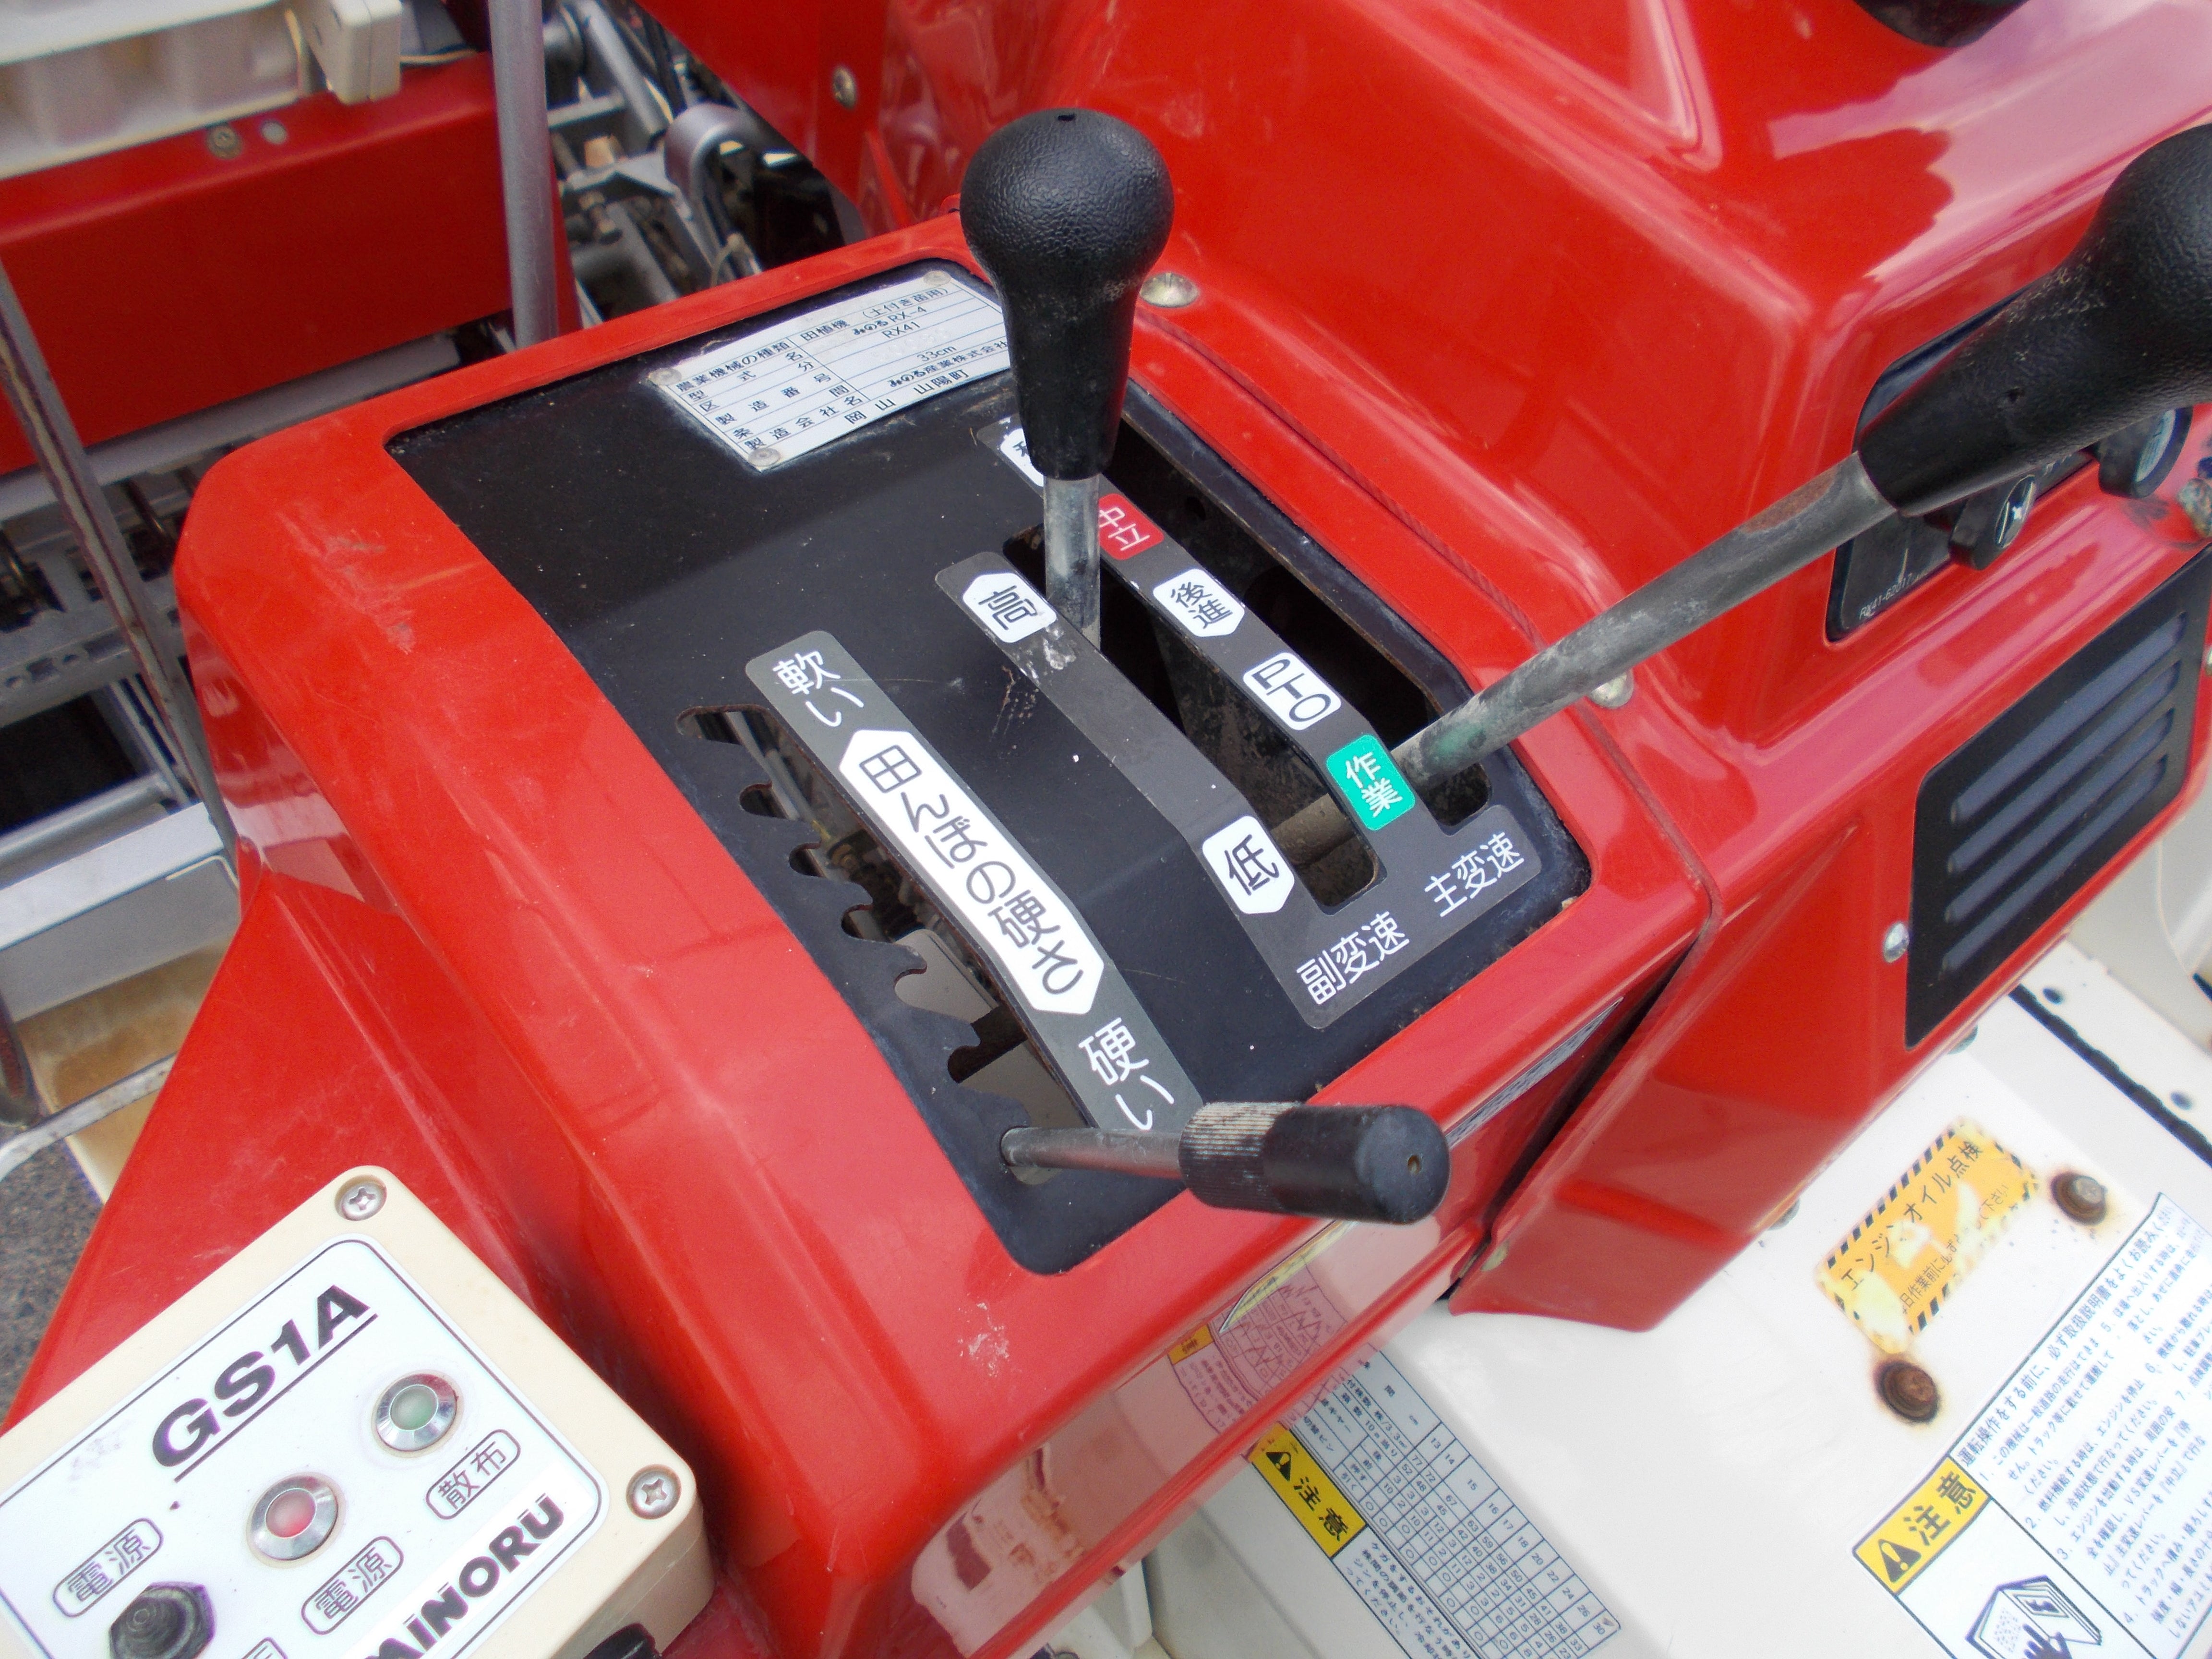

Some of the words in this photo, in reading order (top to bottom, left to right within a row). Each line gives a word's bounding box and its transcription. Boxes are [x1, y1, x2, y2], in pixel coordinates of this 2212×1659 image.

[676, 342, 790, 392] 農業機械の種類
[800, 320, 850, 341] 田植機
[881, 321, 920, 338] RX41
[916, 346, 957, 361] 33cm
[913, 369, 969, 394] 山陽町
[978, 585, 1037, 630] 高
[1169, 581, 1233, 629] 後進
[773, 650, 864, 727] 軟い
[1250, 658, 1332, 722] PTO
[1345, 751, 1403, 817] 作業
[859, 744, 1084, 994] 田んぼの硬さ
[1228, 834, 1278, 896] 低
[1424, 831, 1525, 917] 主変速
[1297, 911, 1410, 1005] 副変速
[1078, 1017, 1174, 1130] 硬い
[152, 1284, 371, 1467] GS1A
[435, 1438, 507, 1510] 散布
[1293, 1476, 1348, 1541] 注意
[1909, 1471, 1976, 1546] 注意
[65, 1529, 150, 1604] 電源
[1383, 1483, 1393, 1494] 10
[1397, 1500, 1406, 1509] 2
[1410, 1515, 1420, 1526] 10
[1424, 1531, 1433, 1541] 11
[1438, 1548, 1446, 1557] 2
[1451, 1563, 1461, 1573] 11
[1466, 1581, 1475, 1590] 3
[1480, 1597, 1489, 1606] 3
[1495, 1614, 1503, 1623] 6
[1509, 1631, 1518, 1640] 6
[1524, 1648, 1532, 1657] 8
[1393, 1475, 1401, 1484] 3
[1407, 1491, 1415, 1500] 3
[1420, 1507, 1429, 1515] 3
[1434, 1522, 1444, 1533] 12
[1448, 1539, 1456, 1548] 3
[1462, 1554, 1472, 1565] 12
[1476, 1573, 1485, 1581] 2
[1490, 1589, 1500, 1598] 2
[1506, 1606, 1515, 1615] 5
[1520, 1623, 1529, 1632] 5
[1401, 1463, 1413, 1475] 52
[1416, 1480, 1426, 1491] 48
[1437, 1504, 1447, 1515] 45
[1457, 1529, 1468, 1540] 42
[1472, 1546, 1482, 1557] 40
[1485, 1562, 1497, 1574] 38
[1500, 1579, 1512, 1591] 34
[1515, 1596, 1526, 1607] 31
[1529, 1613, 1541, 1625] 28
[1544, 1630, 1556, 1643] 26
[1412, 1455, 1422, 1466] 77
[1425, 1470, 1435, 1483] 72
[1445, 1494, 1457, 1505] 67
[1467, 1520, 1479, 1532] 63
[1482, 1536, 1493, 1548] 59
[1496, 1553, 1507, 1565] 56
[1511, 1569, 1523, 1582] 50
[1526, 1588, 1537, 1599] 45
[1540, 1605, 1551, 1615] 41
[1555, 1621, 1567, 1634] 38
[1570, 1638, 1582, 1651] 33
[1431, 1437, 1441, 1449] 13
[1445, 1454, 1455, 1465] 14
[1467, 1479, 1477, 1490] 15
[1489, 1503, 1499, 1514] 16
[1503, 1519, 1513, 1529] 17
[1517, 1536, 1528, 1548] 18
[1531, 1552, 1543, 1565] 20
[1546, 1570, 1559, 1583] 22
[1562, 1587, 1574, 1599] 24
[1576, 1604, 1590, 1617] 26
[1593, 1622, 1605, 1635] 30
[313, 1547, 393, 1621] 電源
